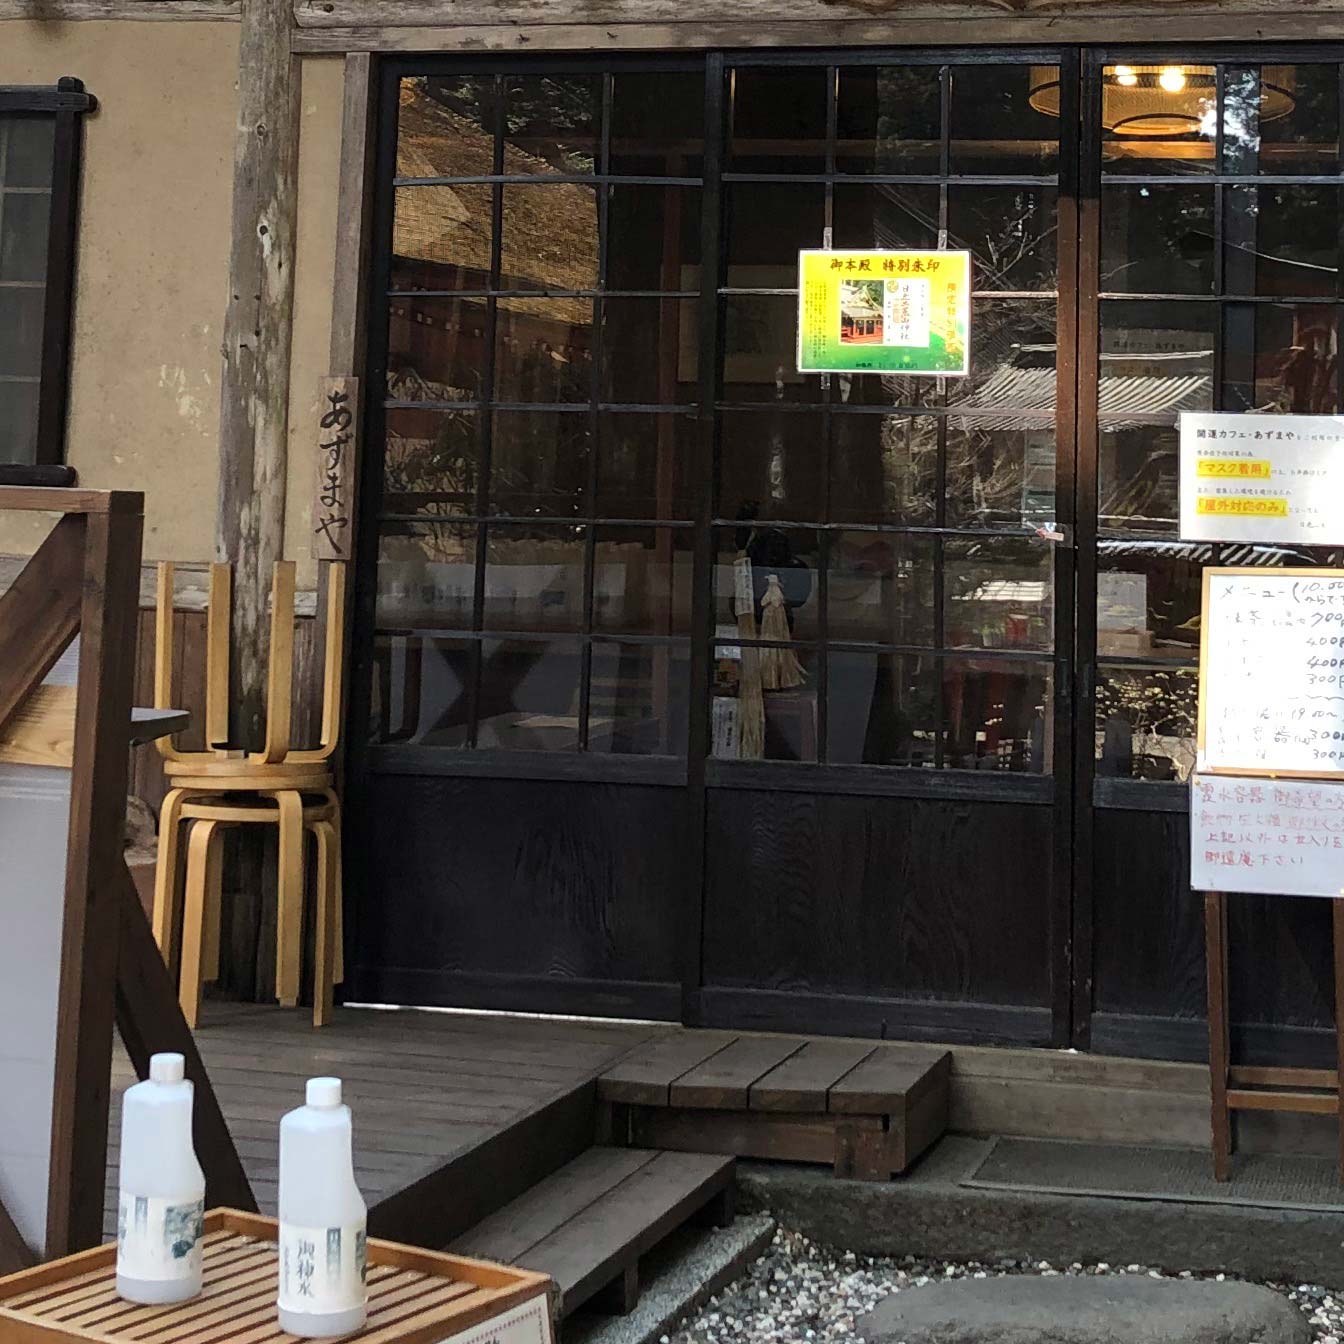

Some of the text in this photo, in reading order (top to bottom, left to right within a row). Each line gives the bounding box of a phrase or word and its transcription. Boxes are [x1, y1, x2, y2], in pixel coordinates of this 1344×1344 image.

[830, 258, 873, 272] 御本殿
[315, 390, 354, 555] あずまや
[1220, 584, 1286, 600] メニュー
